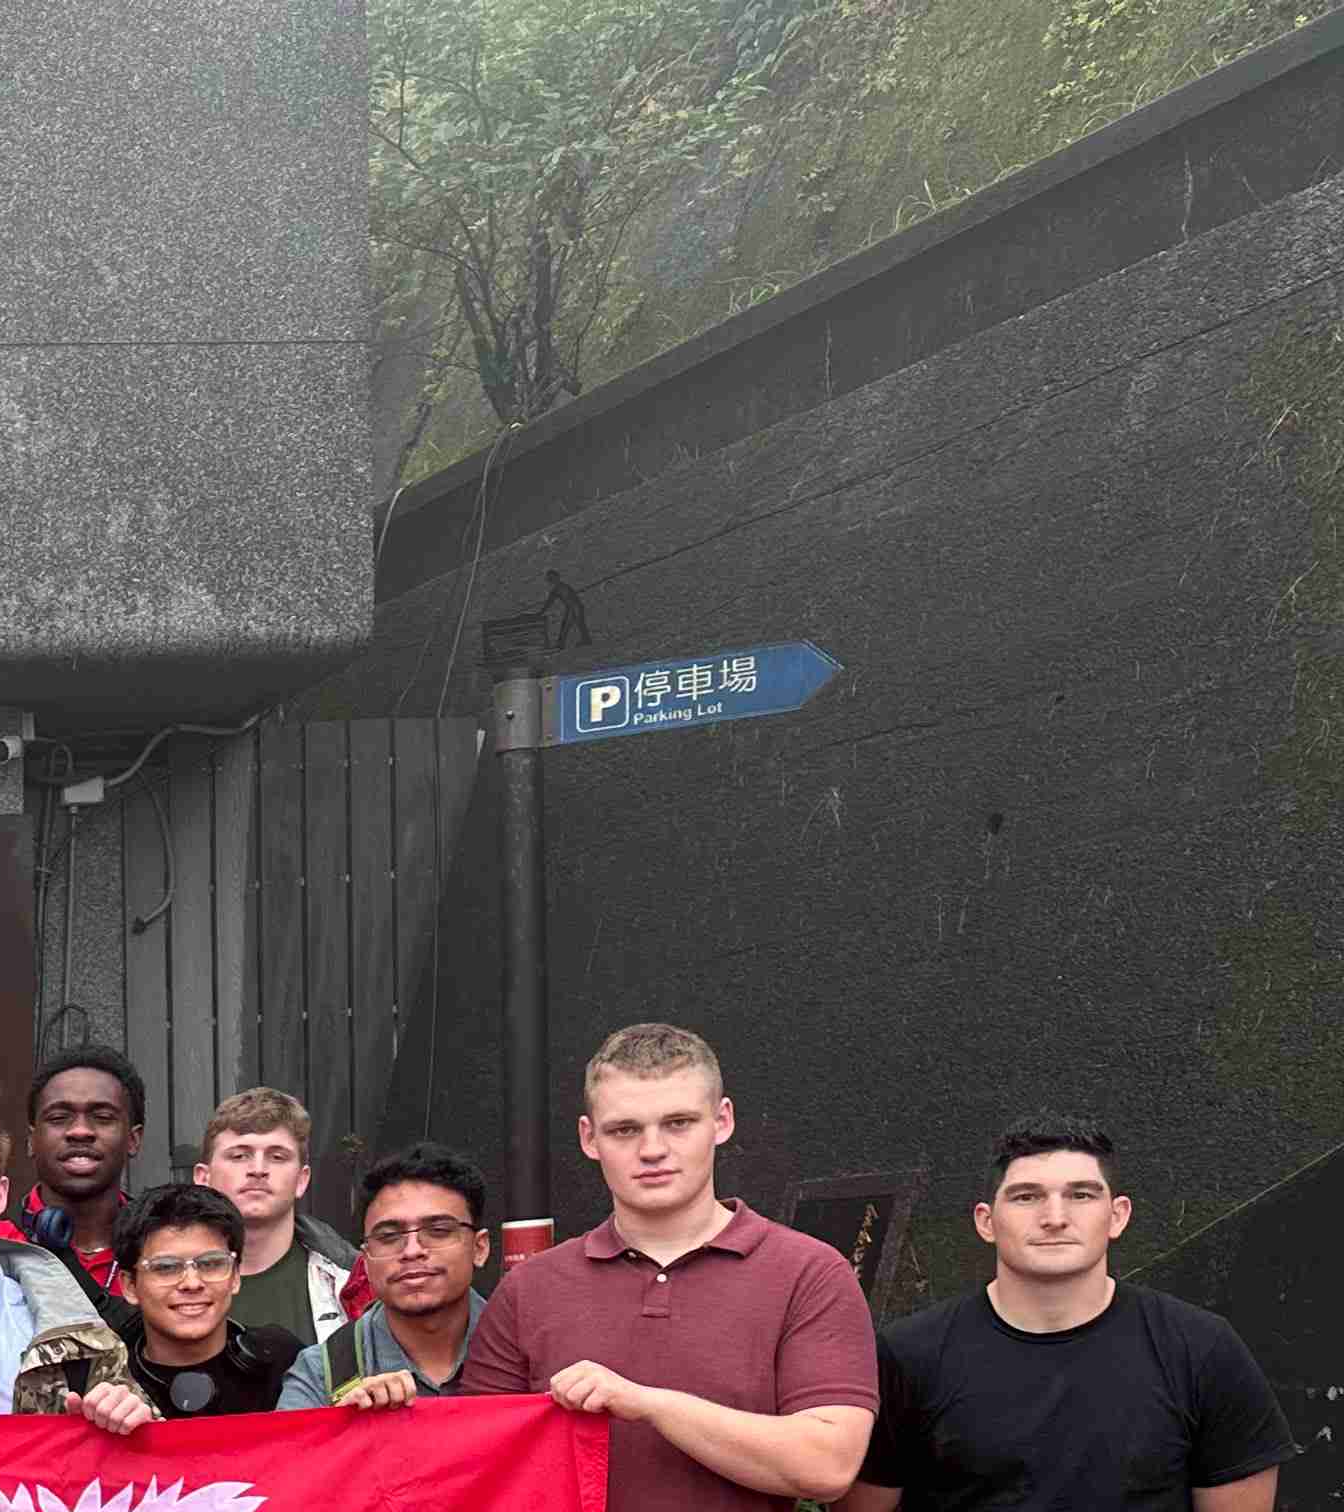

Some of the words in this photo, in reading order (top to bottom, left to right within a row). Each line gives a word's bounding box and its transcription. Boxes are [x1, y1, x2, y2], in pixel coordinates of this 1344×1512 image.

[634, 655, 758, 709] 停車場
[590, 685, 622, 722] P
[633, 706, 693, 726] Parking
[696, 700, 723, 716] Lot
